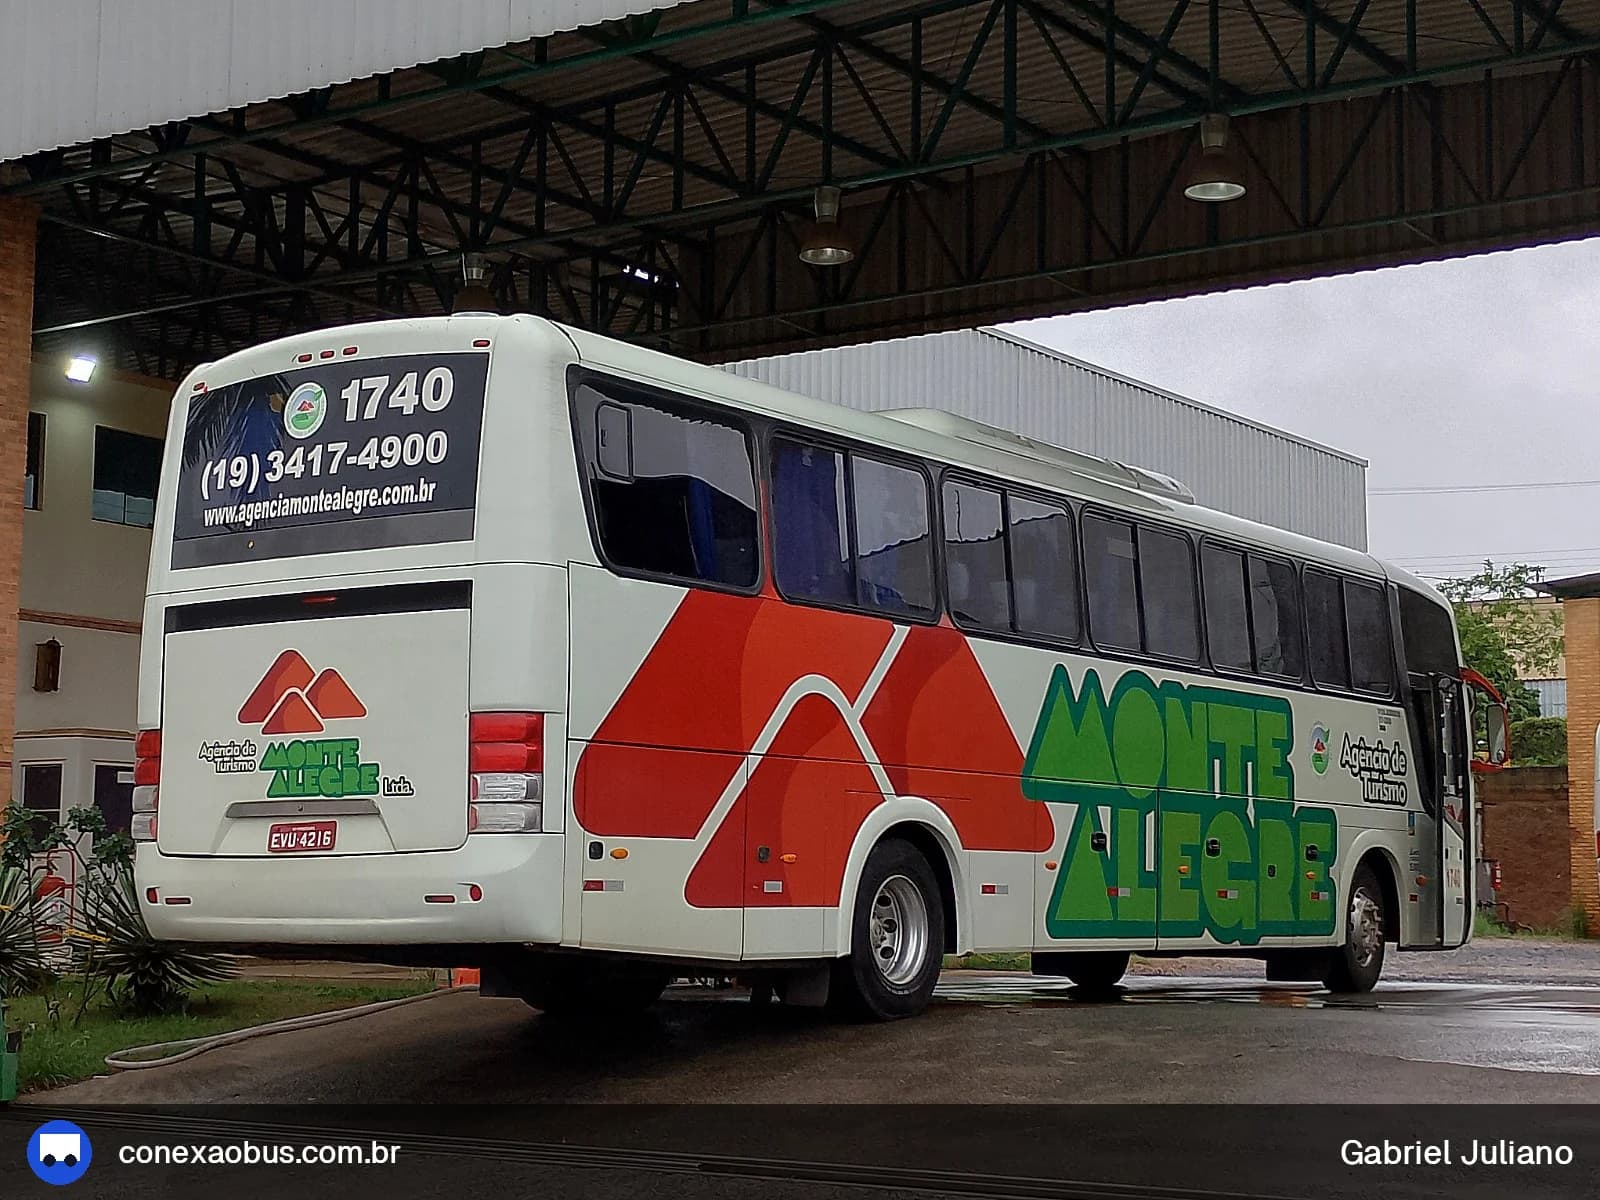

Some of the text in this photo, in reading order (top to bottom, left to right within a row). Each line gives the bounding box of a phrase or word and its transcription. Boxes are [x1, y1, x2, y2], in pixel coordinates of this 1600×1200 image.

[340, 366, 454, 422] 1740
[200, 430, 448, 500] (19) 3417-4900
[202, 477, 437, 527] www.agenciamontealegre.com.br
[241, 739, 256, 755] de
[1026, 666, 1292, 799] MONTE
[215, 757, 256, 772] Turismo
[260, 739, 358, 770] MONTE
[1341, 734, 1406, 776] Agência de
[267, 764, 379, 797] ALEGRE
[384, 777, 413, 795] Ltda.
[1361, 772, 1407, 805] Turismo
[1048, 803, 1336, 941] ALEGRE
